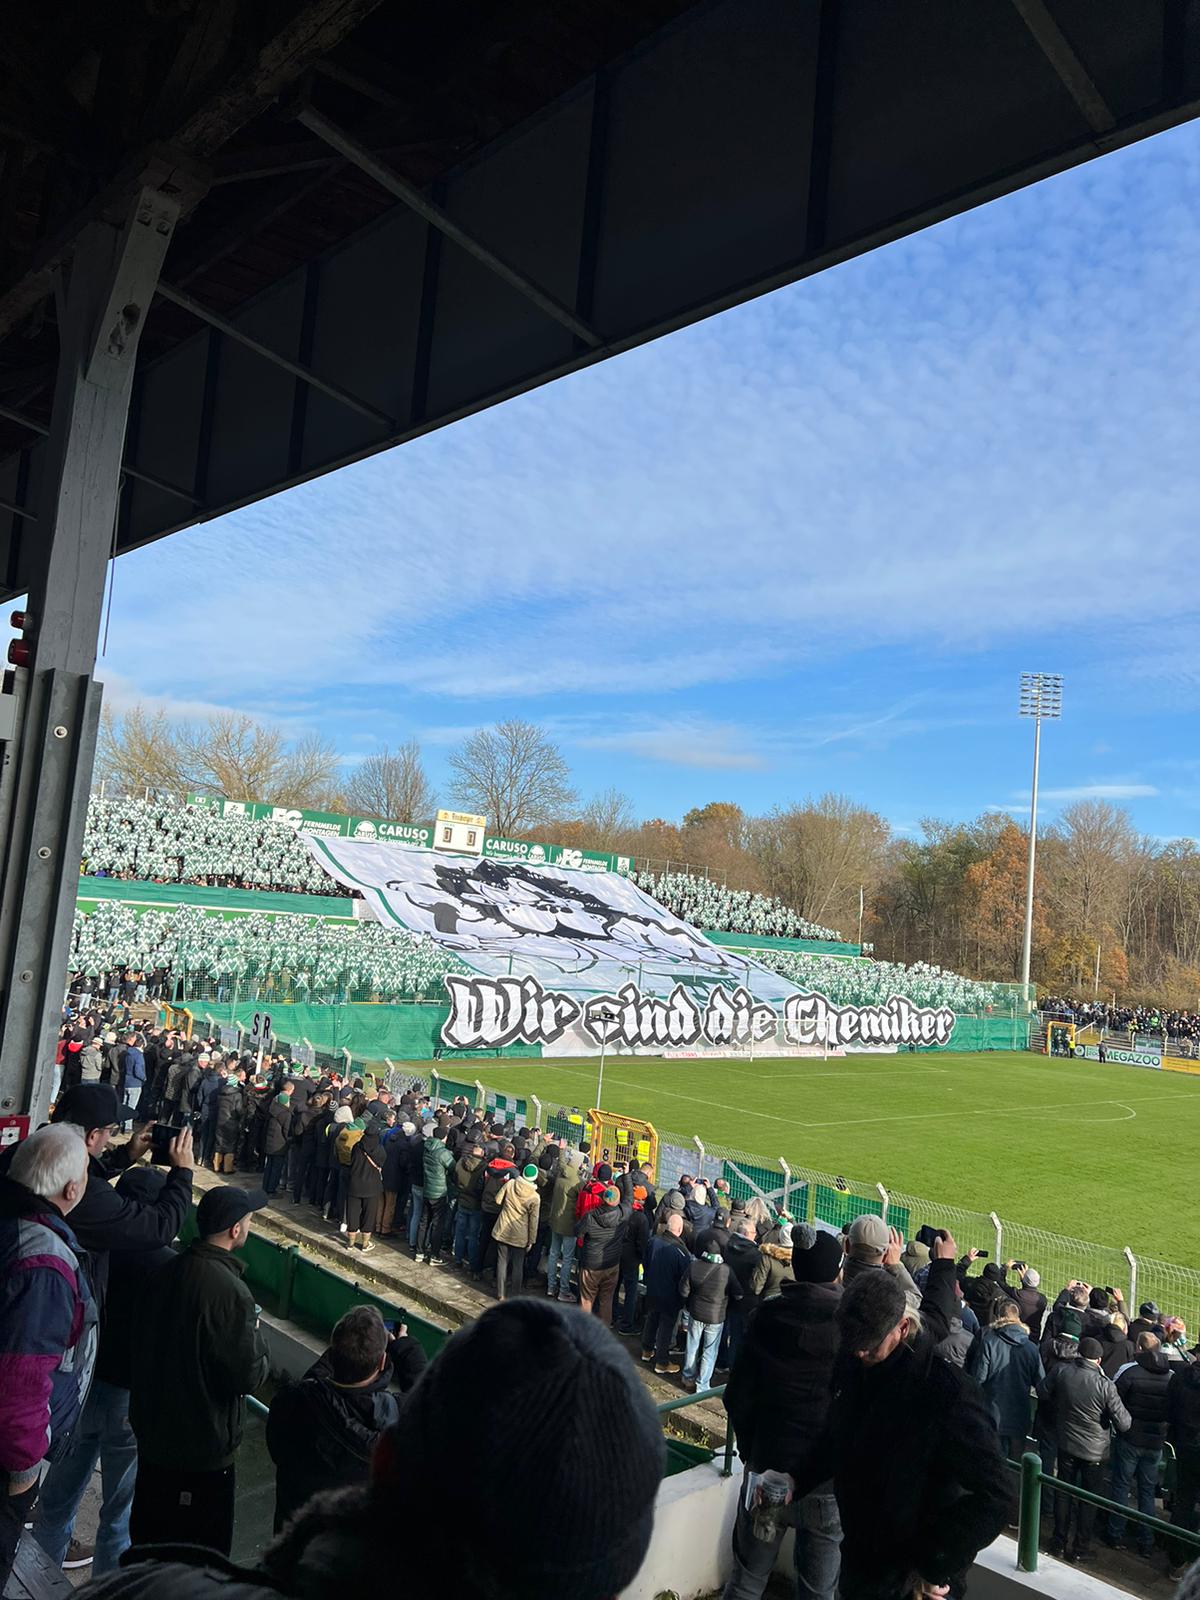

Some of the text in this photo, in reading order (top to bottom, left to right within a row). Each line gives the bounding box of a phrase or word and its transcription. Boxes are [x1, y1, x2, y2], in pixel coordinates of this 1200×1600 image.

[301, 827, 340, 837] MONTAGEN
[304, 820, 341, 831] FERNMELDE
[379, 823, 429, 841] CARUSO
[486, 839, 528, 854] CARUSO
[442, 974, 957, 1048] Wir sind die Chemiker
[1107, 1050, 1160, 1066] MEGAZOO
